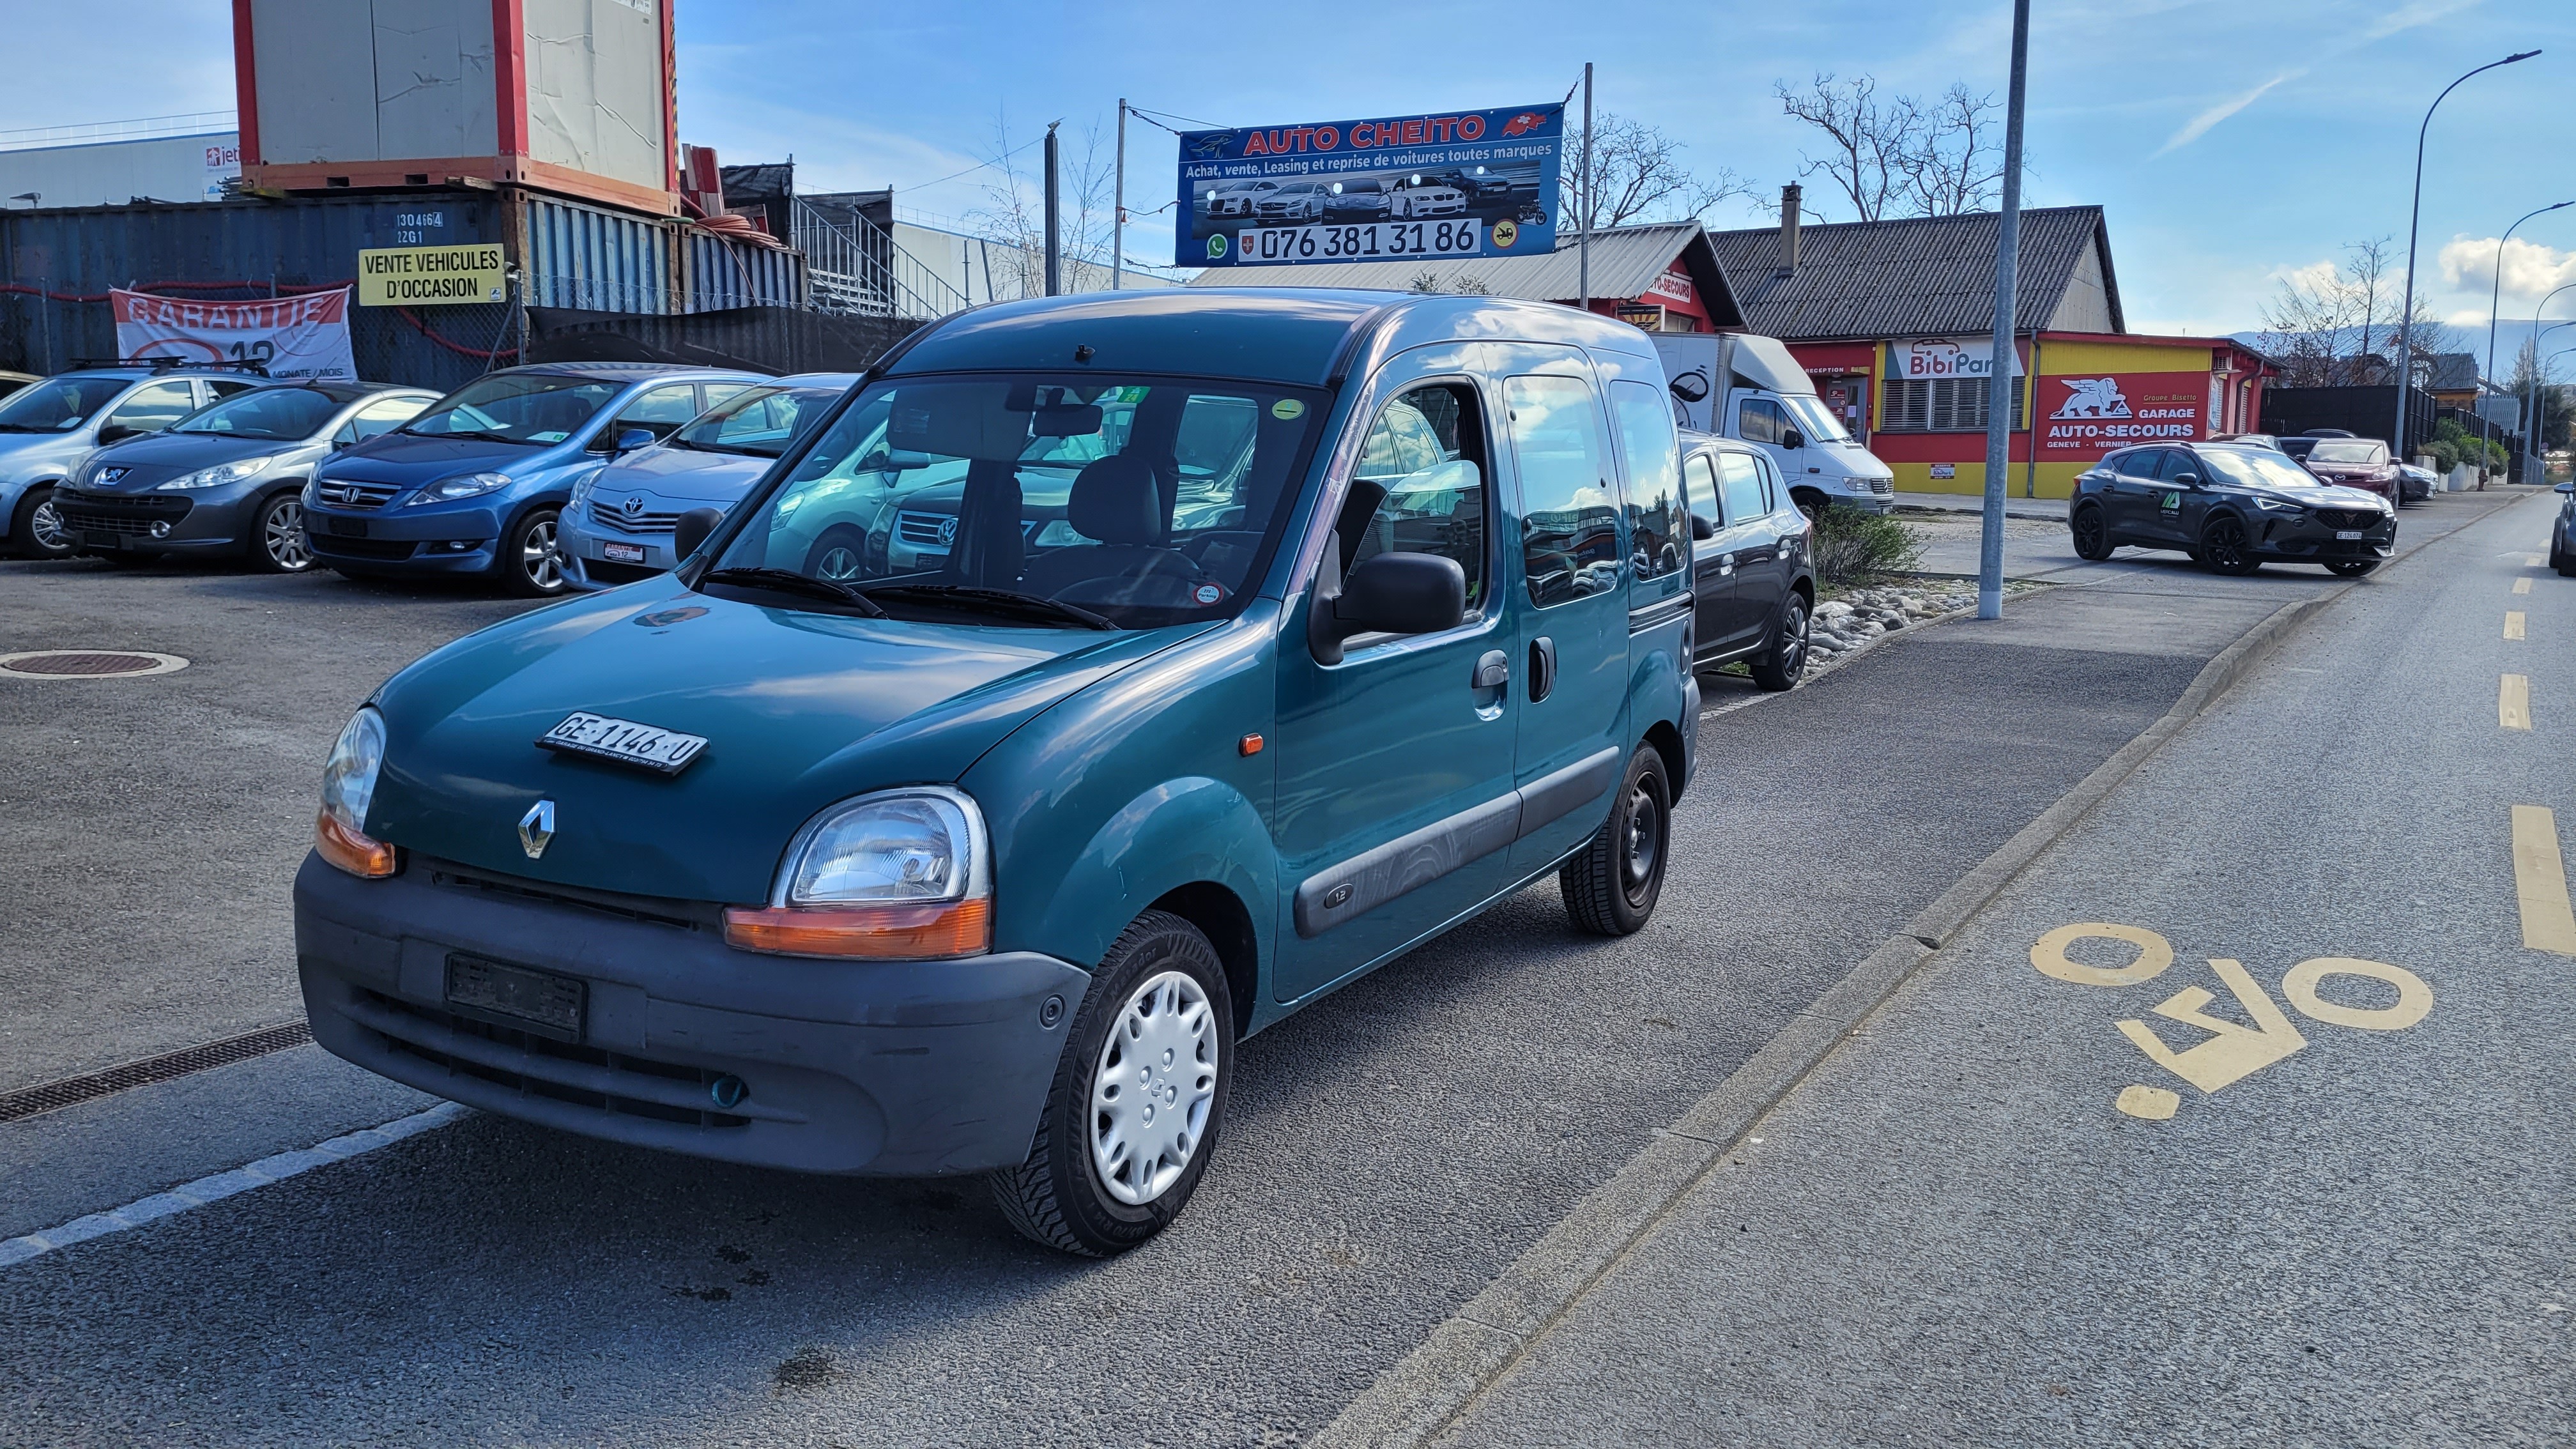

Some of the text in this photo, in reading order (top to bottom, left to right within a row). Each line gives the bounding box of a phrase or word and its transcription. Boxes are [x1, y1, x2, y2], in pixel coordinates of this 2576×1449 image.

[1243, 114, 1486, 157] AUTO CHEITO
[222, 146, 240, 165] jet
[1185, 144, 1552, 178] Achat, vente, Leasing et reprise de voitures toutes marques
[397, 231, 422, 243] 22G1
[1261, 220, 1474, 259] 076 381 31 86
[365, 250, 499, 274] VENTE VEHICULES
[387, 277, 478, 299] D'OCCASION
[128, 298, 324, 329] GARANTIE
[273, 369, 311, 378] MONATE
[2138, 408, 2195, 418] GARAGE
[2048, 424, 2194, 438] AUTO-SECOURS
[556, 740, 578, 749] GARAGE
